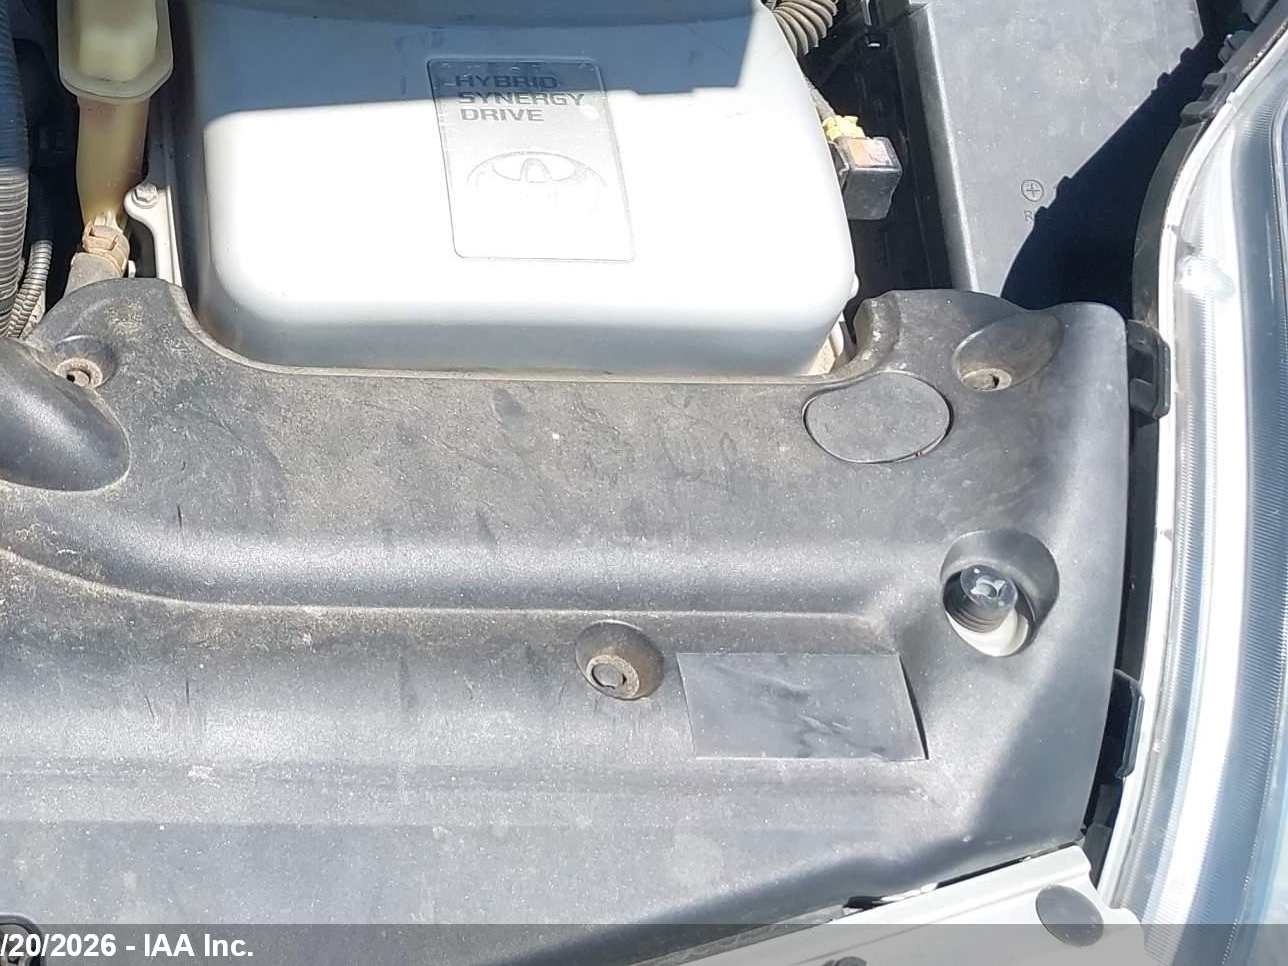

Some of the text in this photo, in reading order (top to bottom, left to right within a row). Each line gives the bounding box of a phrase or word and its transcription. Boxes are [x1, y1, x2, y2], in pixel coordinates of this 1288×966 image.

[455, 75, 558, 89] HYBRID
[458, 91, 585, 106] SYNERGY
[460, 108, 545, 122] DRIVE
